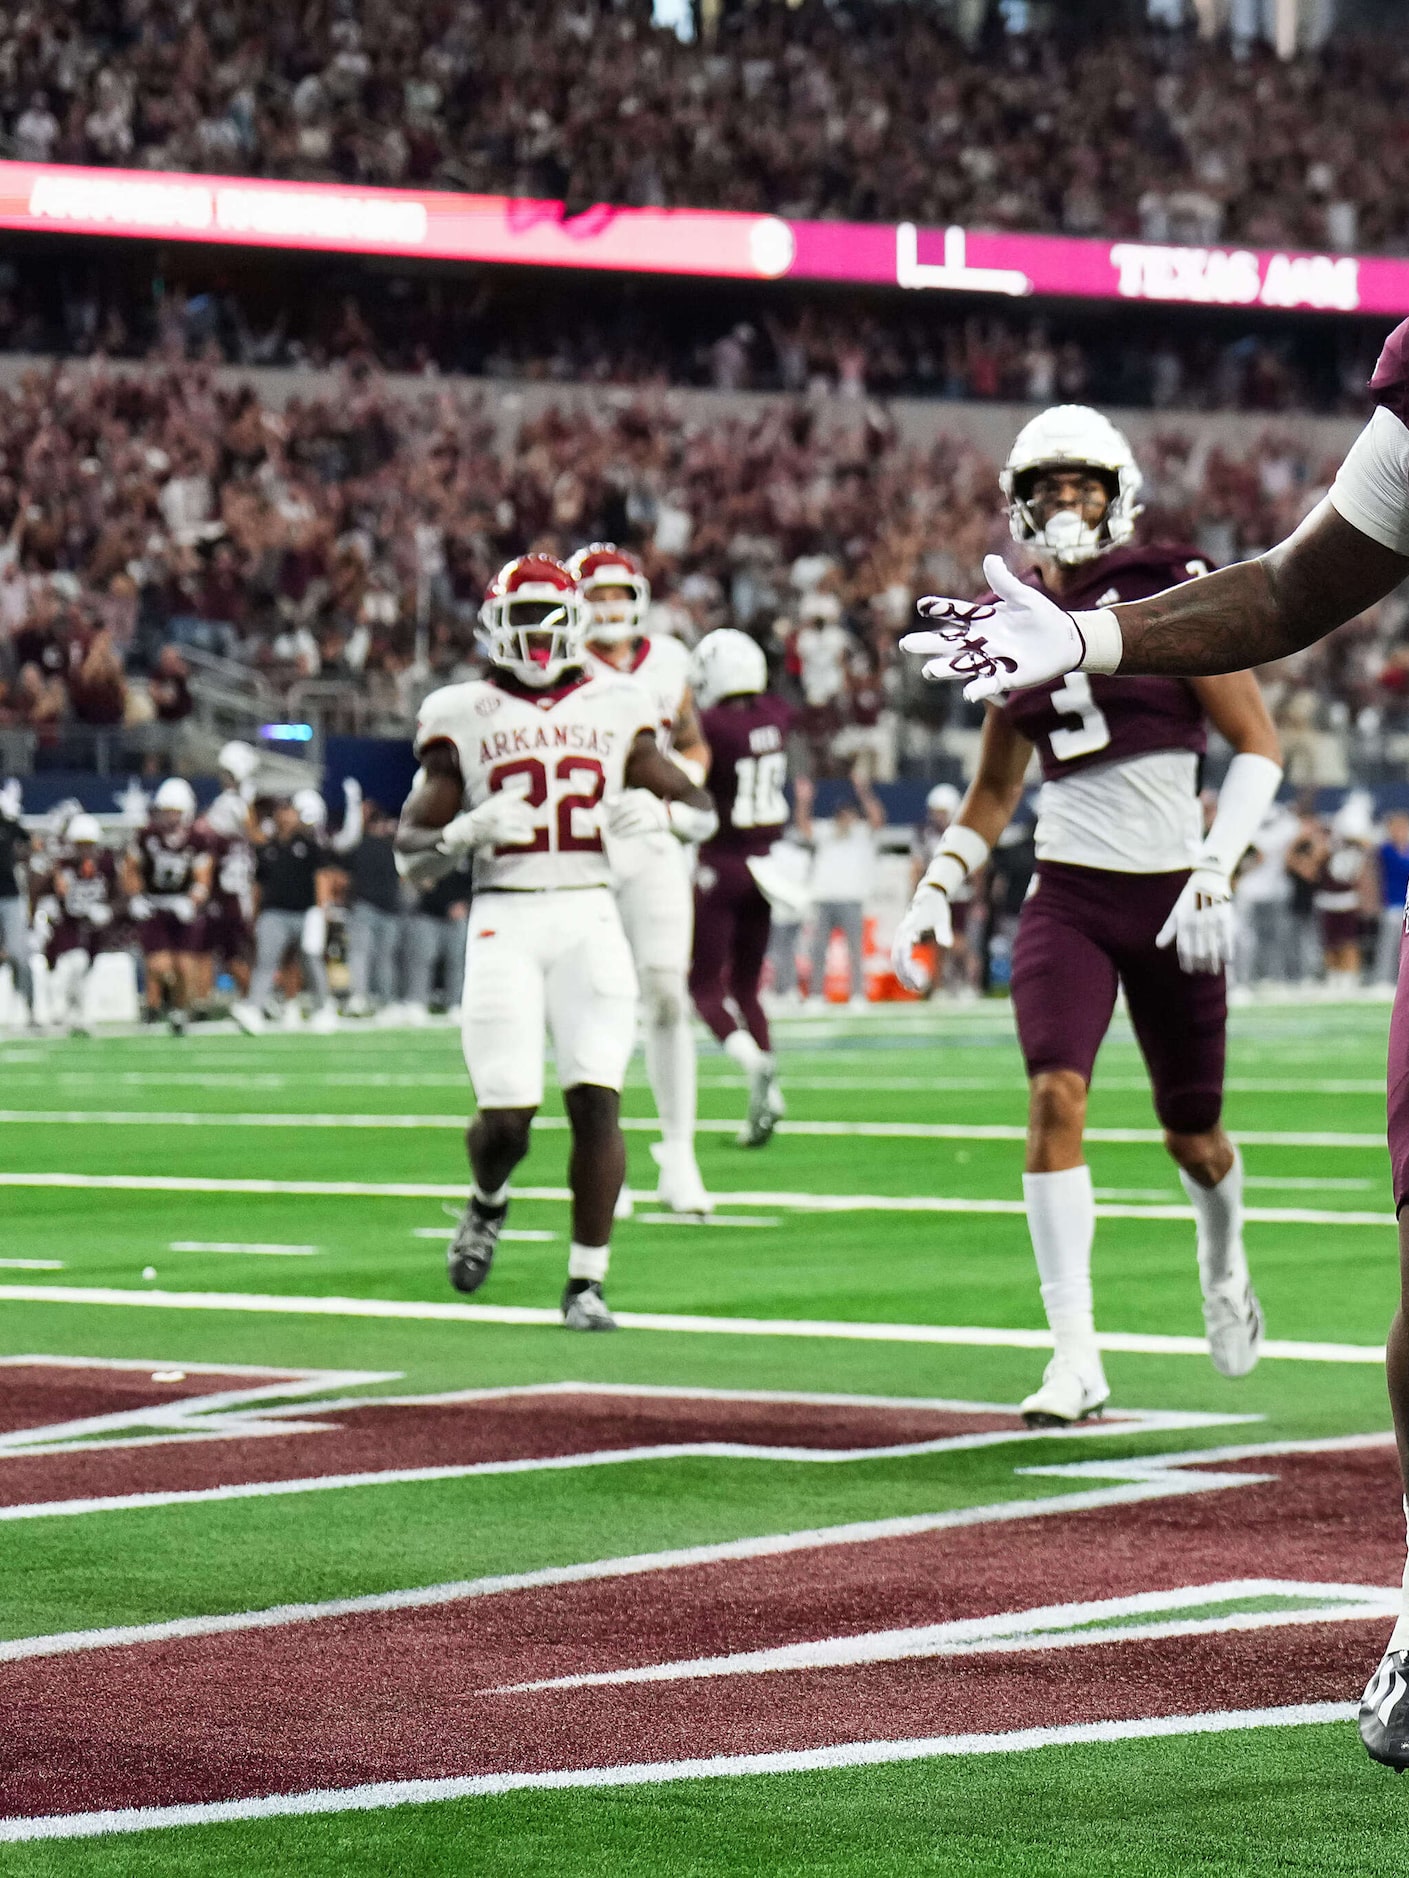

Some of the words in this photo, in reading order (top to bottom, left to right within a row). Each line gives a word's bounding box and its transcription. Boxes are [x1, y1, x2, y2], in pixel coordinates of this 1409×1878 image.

[477, 724, 616, 767] ARKANSAS
[1048, 671, 1110, 760] 3
[488, 755, 607, 856] 22
